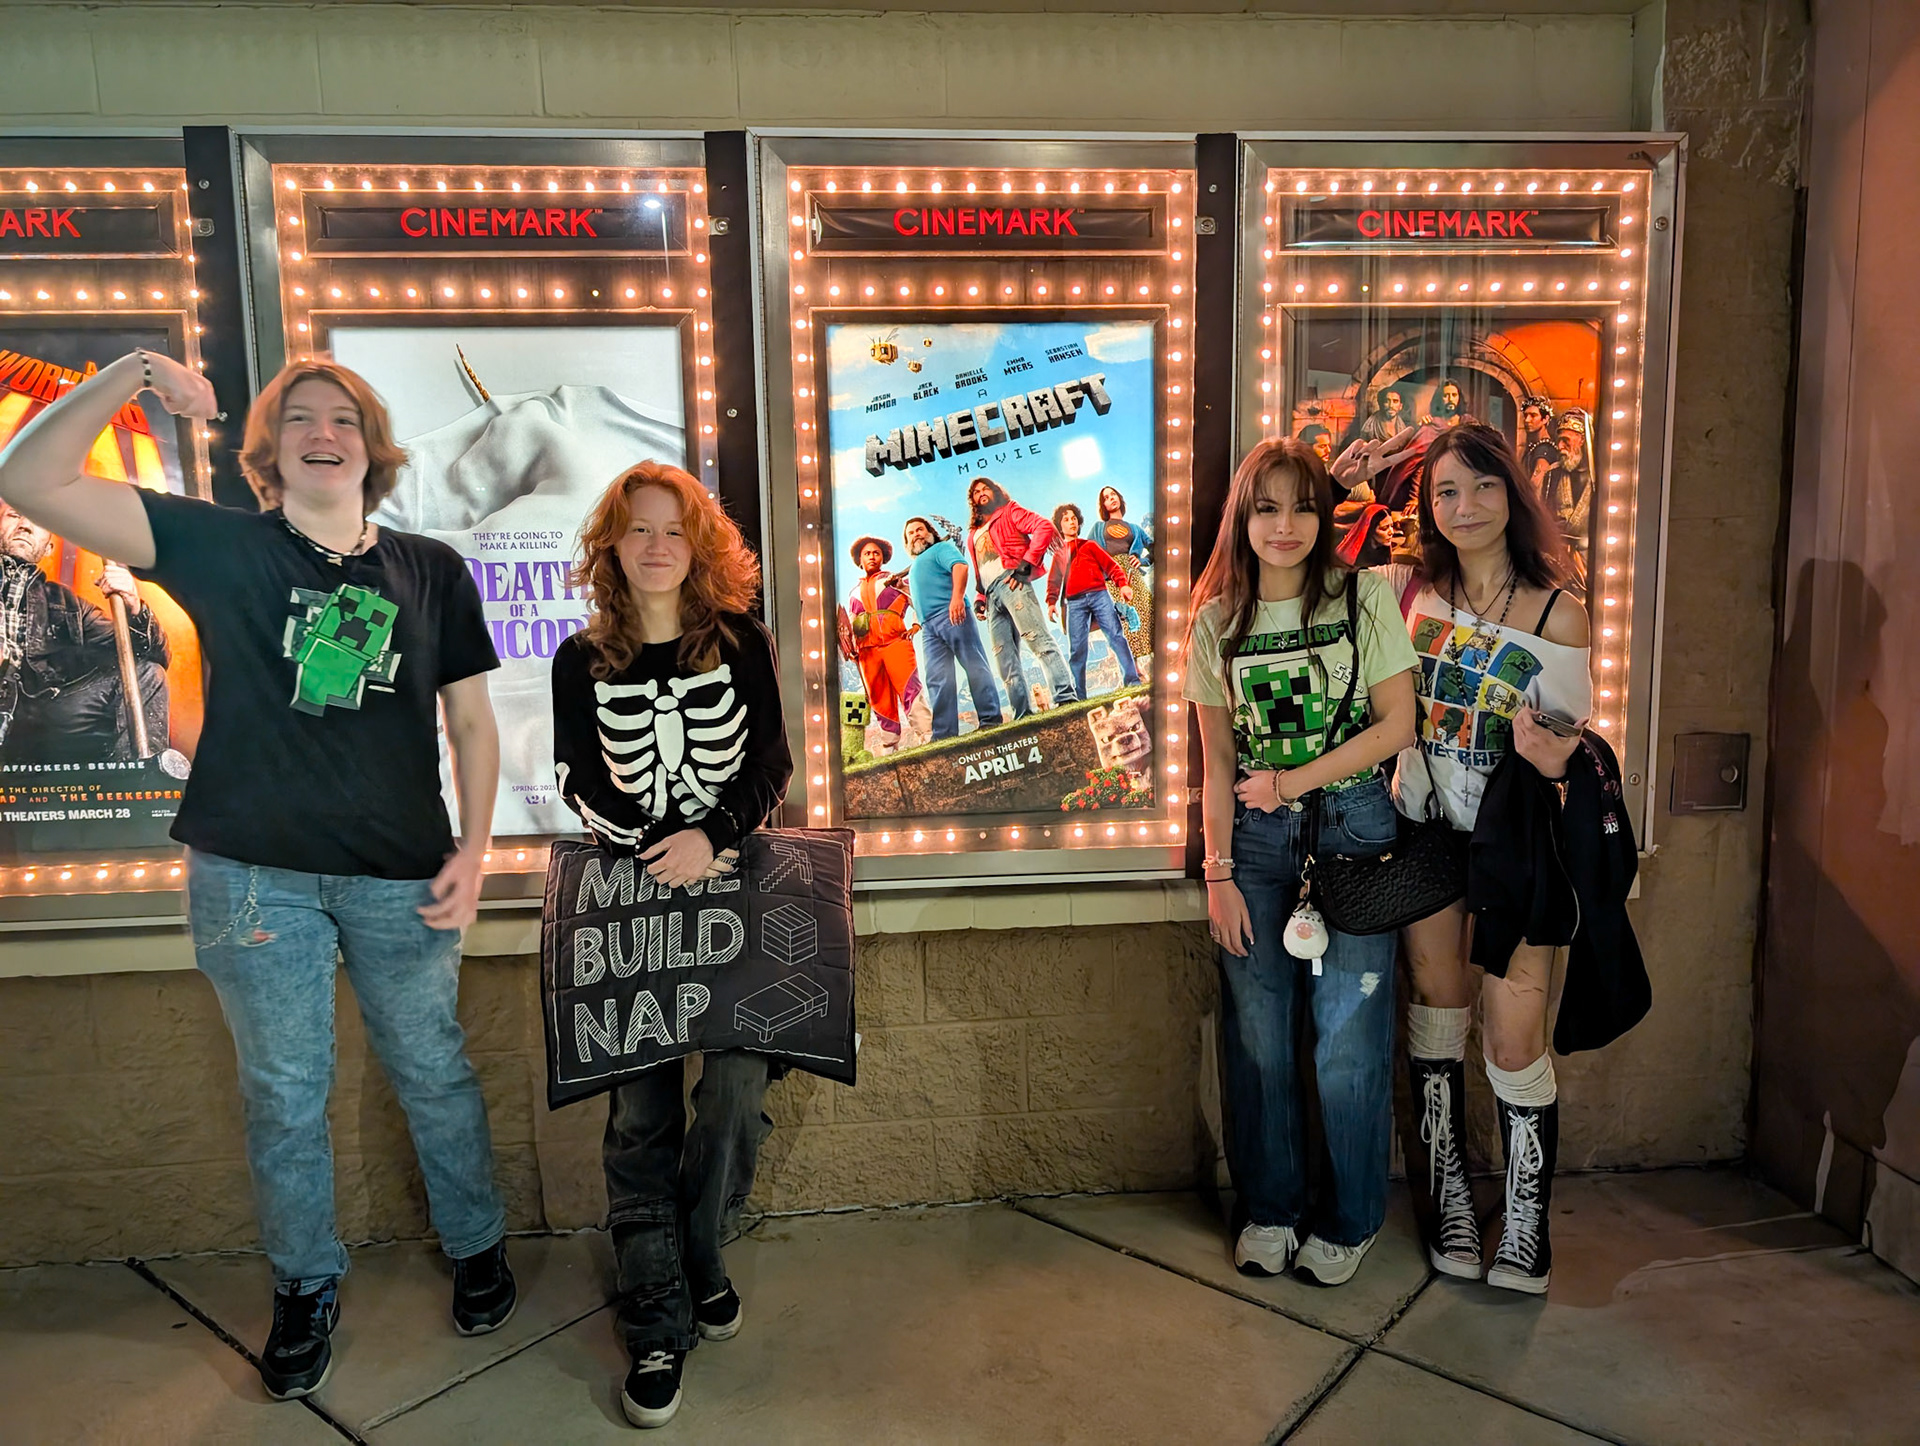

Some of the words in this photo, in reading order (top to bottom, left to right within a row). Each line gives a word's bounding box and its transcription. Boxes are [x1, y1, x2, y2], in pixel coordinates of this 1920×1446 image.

[400, 207, 598, 237] CINEMARK
[893, 207, 1079, 237] CINEMARK
[1357, 210, 1534, 238] CINEMARK
[1045, 342, 1079, 356] SEBASTIAN
[1048, 348, 1084, 364] HANSEN
[1003, 361, 1034, 376] MYERS
[1006, 356, 1026, 367] EMMA
[955, 367, 984, 380] DANIELLE
[917, 382, 932, 391] JACK
[955, 374, 988, 389] BROOKS
[871, 393, 891, 403] JASON
[913, 387, 939, 401] BLACK
[978, 388, 988, 399] A
[866, 398, 897, 414] MOMOA
[865, 372, 1113, 478] MINECRAFT
[957, 443, 1042, 476] MOVIE
[472, 531, 511, 541] THEY'RE
[513, 531, 548, 540] GOING
[549, 531, 564, 539] TO
[480, 542, 508, 550] MAKE
[510, 542, 518, 550] A
[519, 541, 558, 550] KILLING
[509, 604, 526, 617] OF
[530, 603, 539, 617] A
[958, 751, 982, 765] ONLY
[984, 748, 995, 758] IN
[996, 735, 1039, 754] THEATERS
[88, 761, 146, 771] BEWARE
[964, 752, 1025, 785] APRIL
[1027, 745, 1043, 764] 4
[9, 786, 28, 794] THE
[32, 785, 84, 794] DIRECTOR
[89, 784, 102, 792] OF
[60, 793, 88, 802] THE
[96, 790, 182, 802] BEEKEEPER
[3, 810, 66, 822] THEATERS
[68, 808, 113, 820] MARCH
[115, 808, 131, 819] 28
[574, 908, 744, 987] BUILD
[574, 983, 711, 1063] NAP
